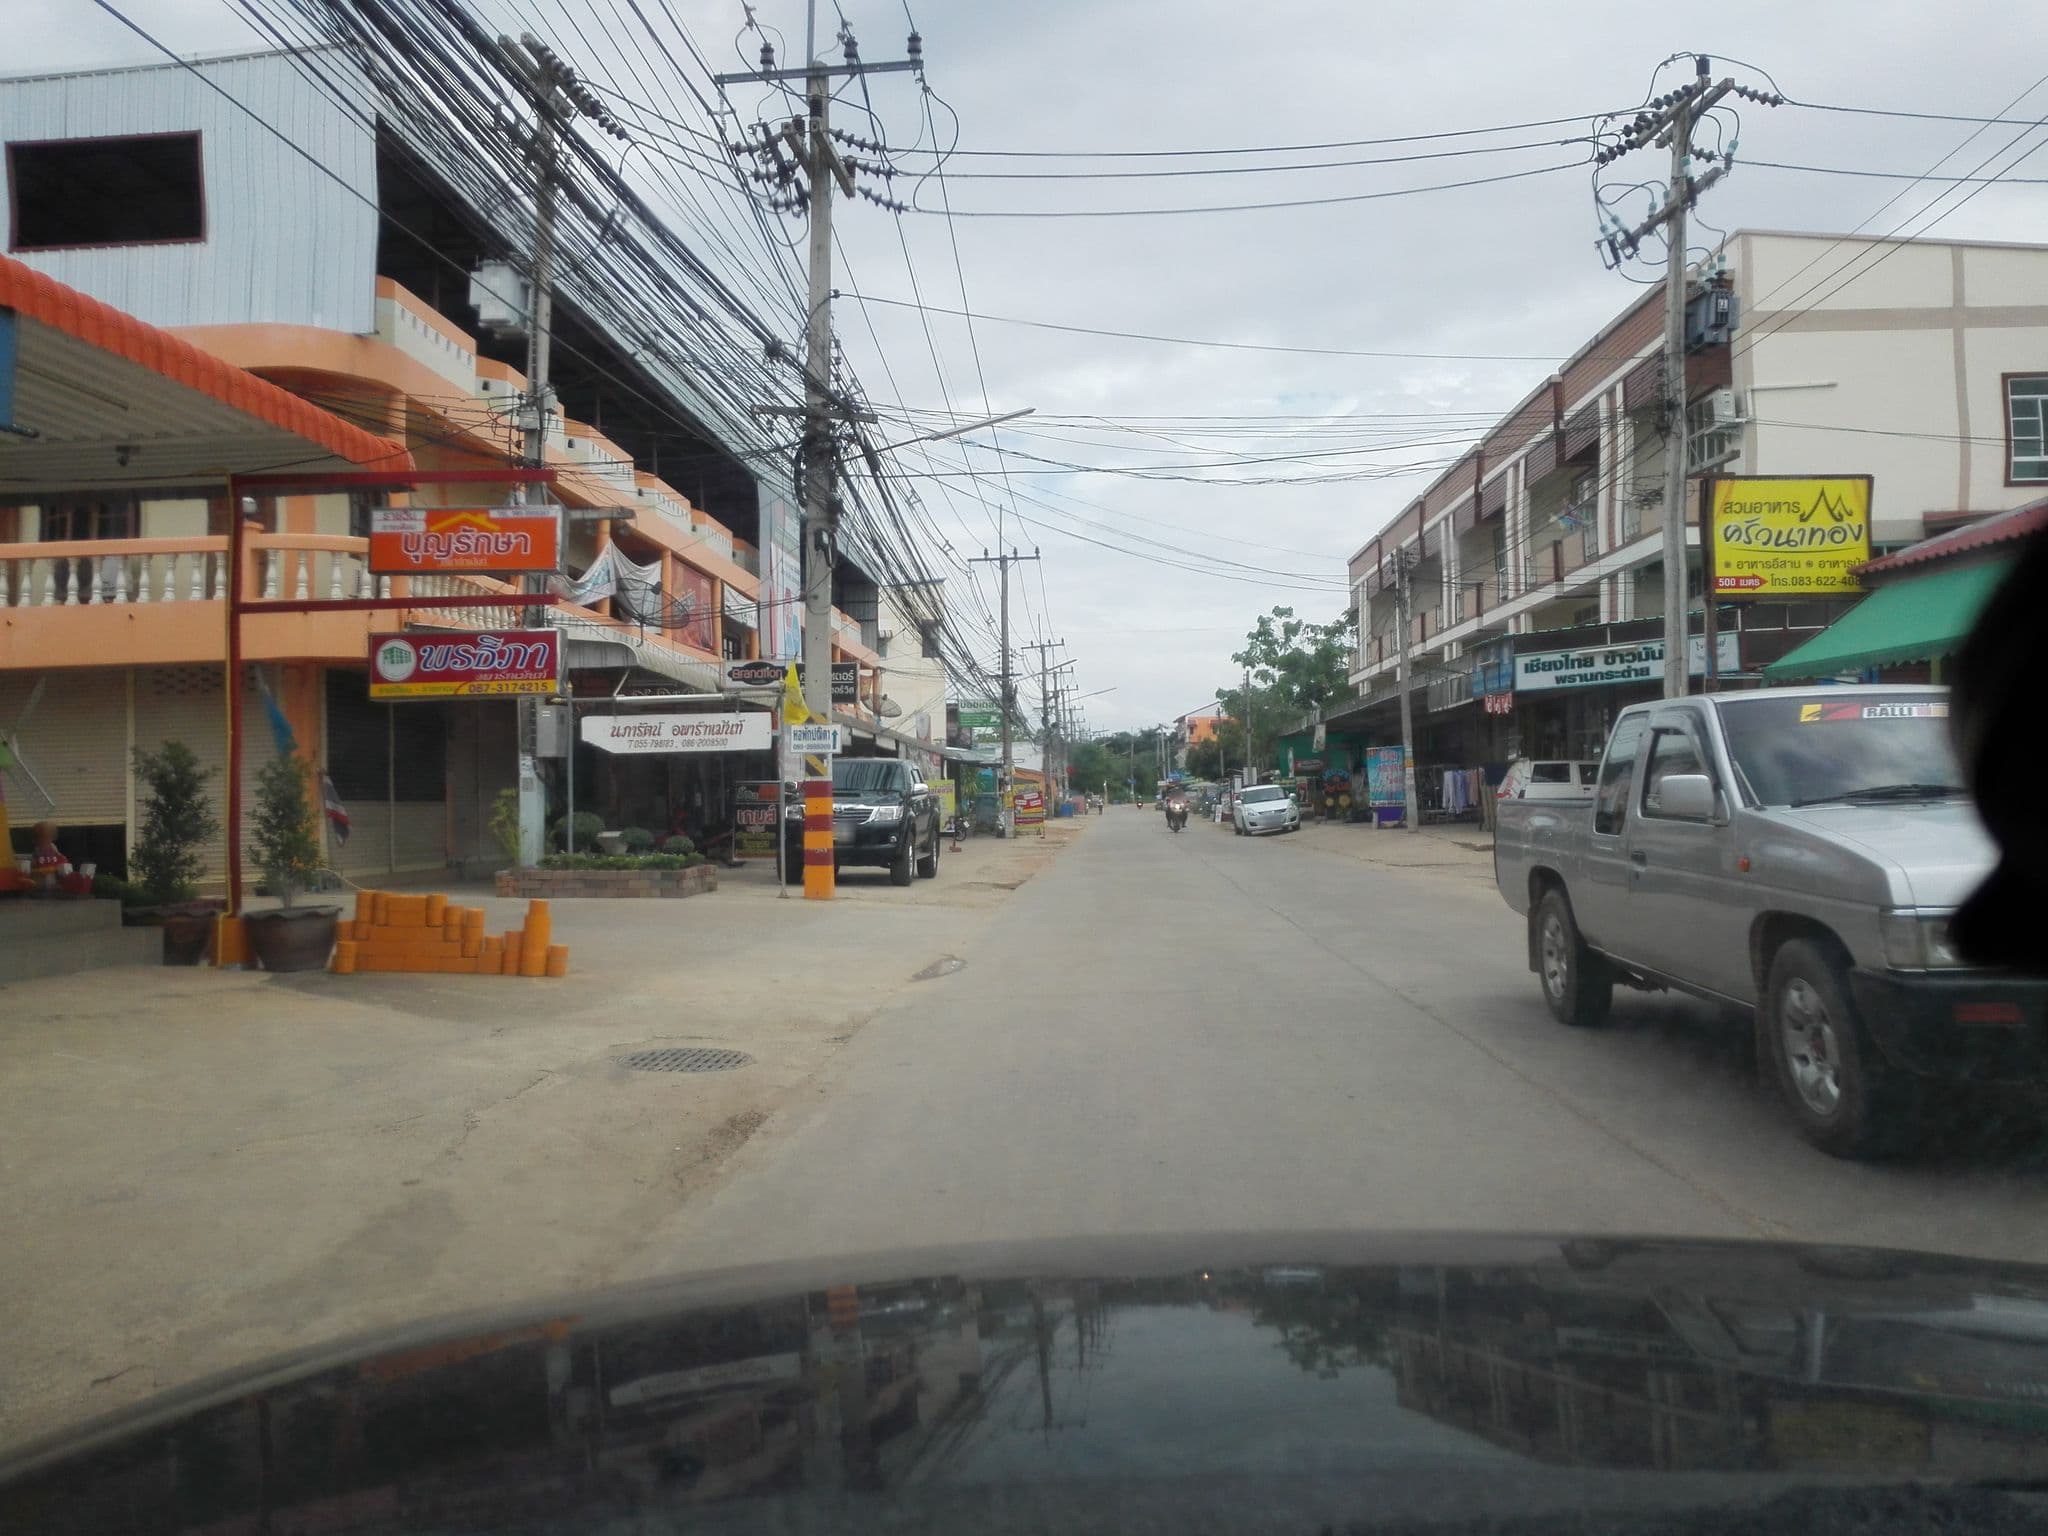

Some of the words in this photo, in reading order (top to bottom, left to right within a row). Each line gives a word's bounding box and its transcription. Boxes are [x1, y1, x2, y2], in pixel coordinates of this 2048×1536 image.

[1723, 500, 1800, 514] สวนอาหาร
[1723, 518, 1864, 547] ครัวนาทอง
[402, 526, 530, 563] บุญรักษา
[1736, 558, 1801, 570] อาหารอีสาน
[1718, 578, 1736, 587] 500
[1603, 643, 1665, 667] ข้าวมัน
[1554, 666, 1650, 685] พรานกระต่าย
[468, 682, 549, 694] 087-3174215
